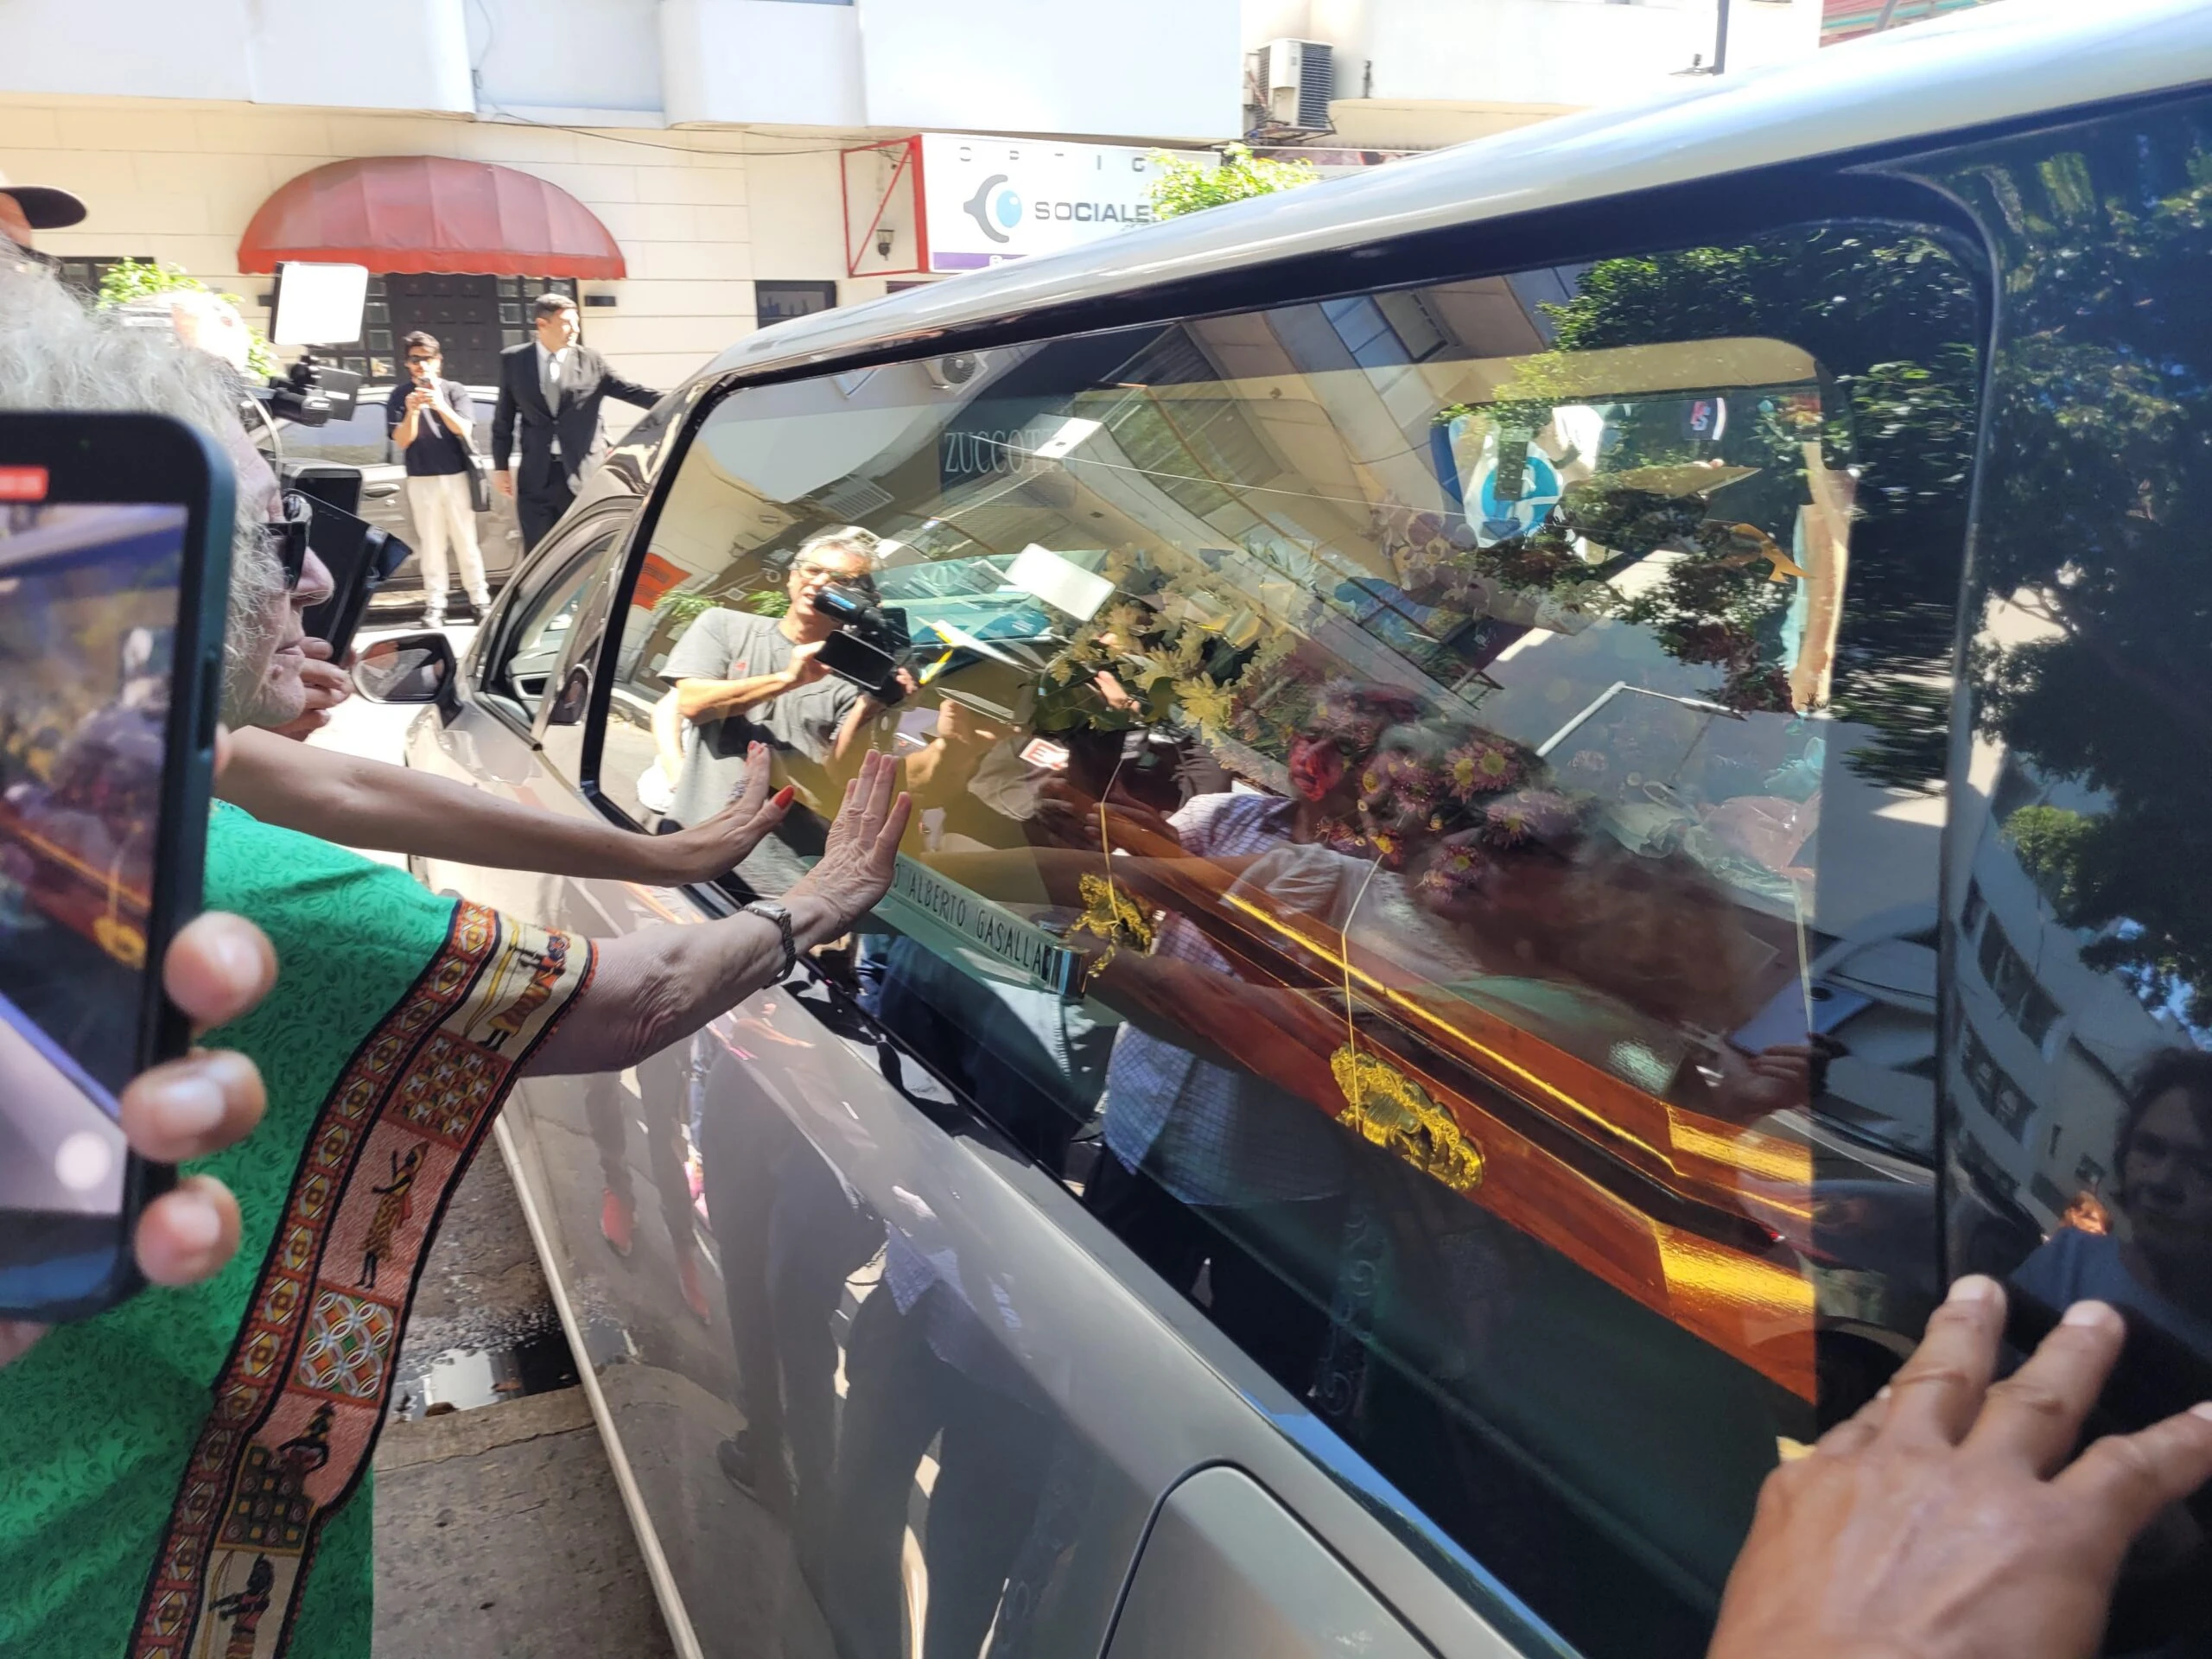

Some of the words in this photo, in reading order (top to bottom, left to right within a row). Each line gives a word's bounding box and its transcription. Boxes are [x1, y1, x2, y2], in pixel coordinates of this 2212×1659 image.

[1034, 201, 1157, 223] SOCIALE
[908, 872, 967, 927] ALBERTO
[976, 909, 1042, 976] GASALLA
